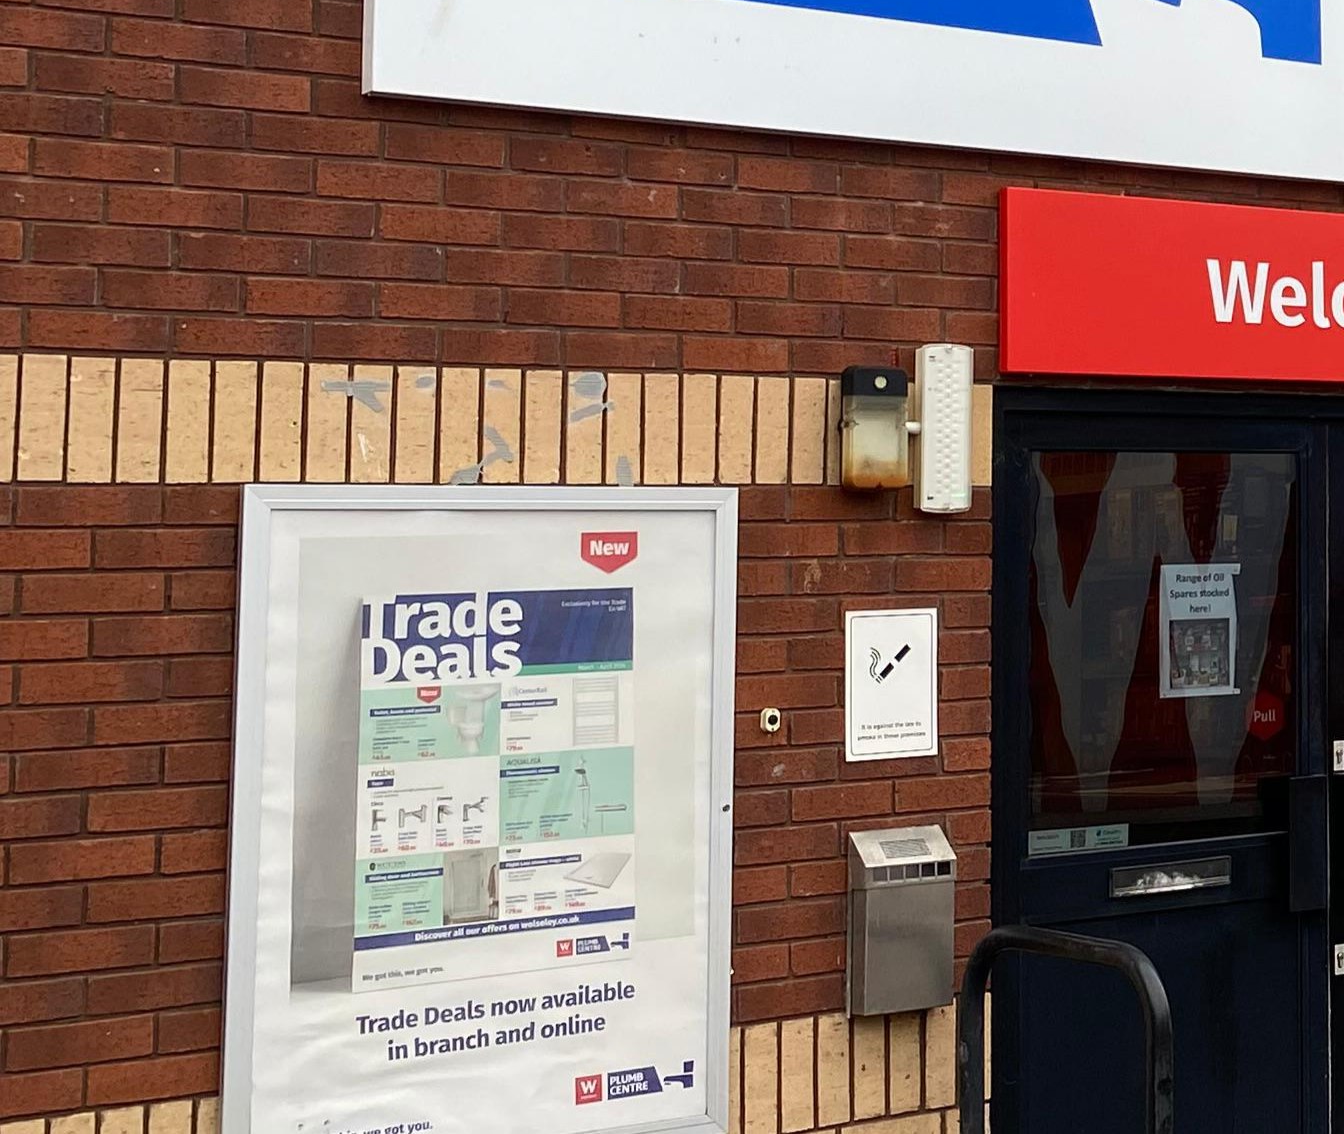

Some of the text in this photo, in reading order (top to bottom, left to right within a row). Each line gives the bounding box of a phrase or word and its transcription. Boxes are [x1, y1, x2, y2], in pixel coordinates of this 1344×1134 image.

[589, 539, 630, 556] New
[1176, 574, 1201, 584] Range
[1213, 573, 1224, 581] Oil
[1170, 588, 1229, 599] Spares stocked
[363, 592, 524, 639] Trade
[361, 634, 521, 681] Deals
[1253, 709, 1276, 723] Pull
[415, 915, 579, 941] Discover all our offers on wolseley.co.uk
[560, 942, 571, 951] W
[374, 973, 387, 982] got
[356, 982, 635, 1034] Trade Deals now available
[387, 1014, 606, 1060] in branch and online
[609, 1072, 644, 1085] PLUMB
[580, 1080, 597, 1095] W
[609, 1081, 649, 1095] CENTRE
[407, 1121, 434, 1134] you.
